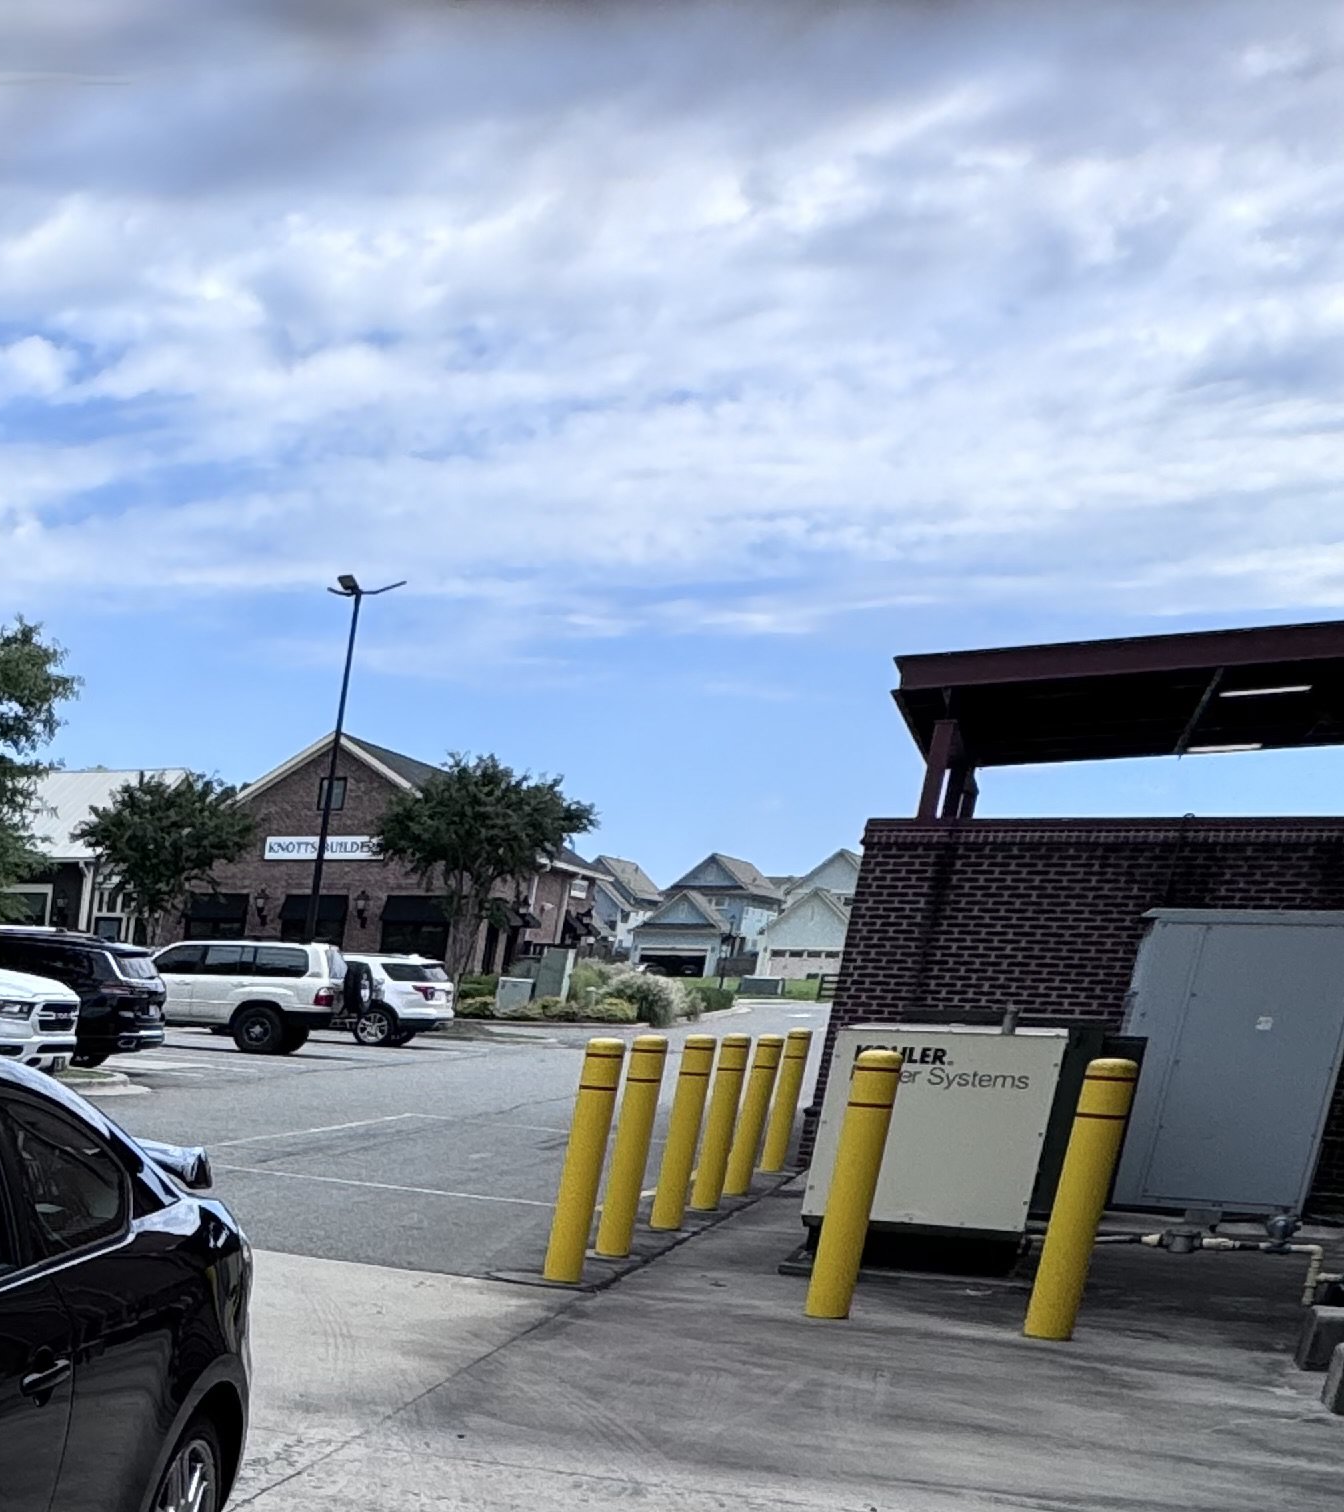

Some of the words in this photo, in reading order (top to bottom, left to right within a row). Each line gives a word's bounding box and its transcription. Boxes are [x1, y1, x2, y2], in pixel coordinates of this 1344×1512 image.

[268, 841, 318, 854] KNOTTS
[324, 841, 381, 854] BUILDE
[854, 1044, 947, 1066] KLER
[927, 1066, 1030, 1090] Systems
